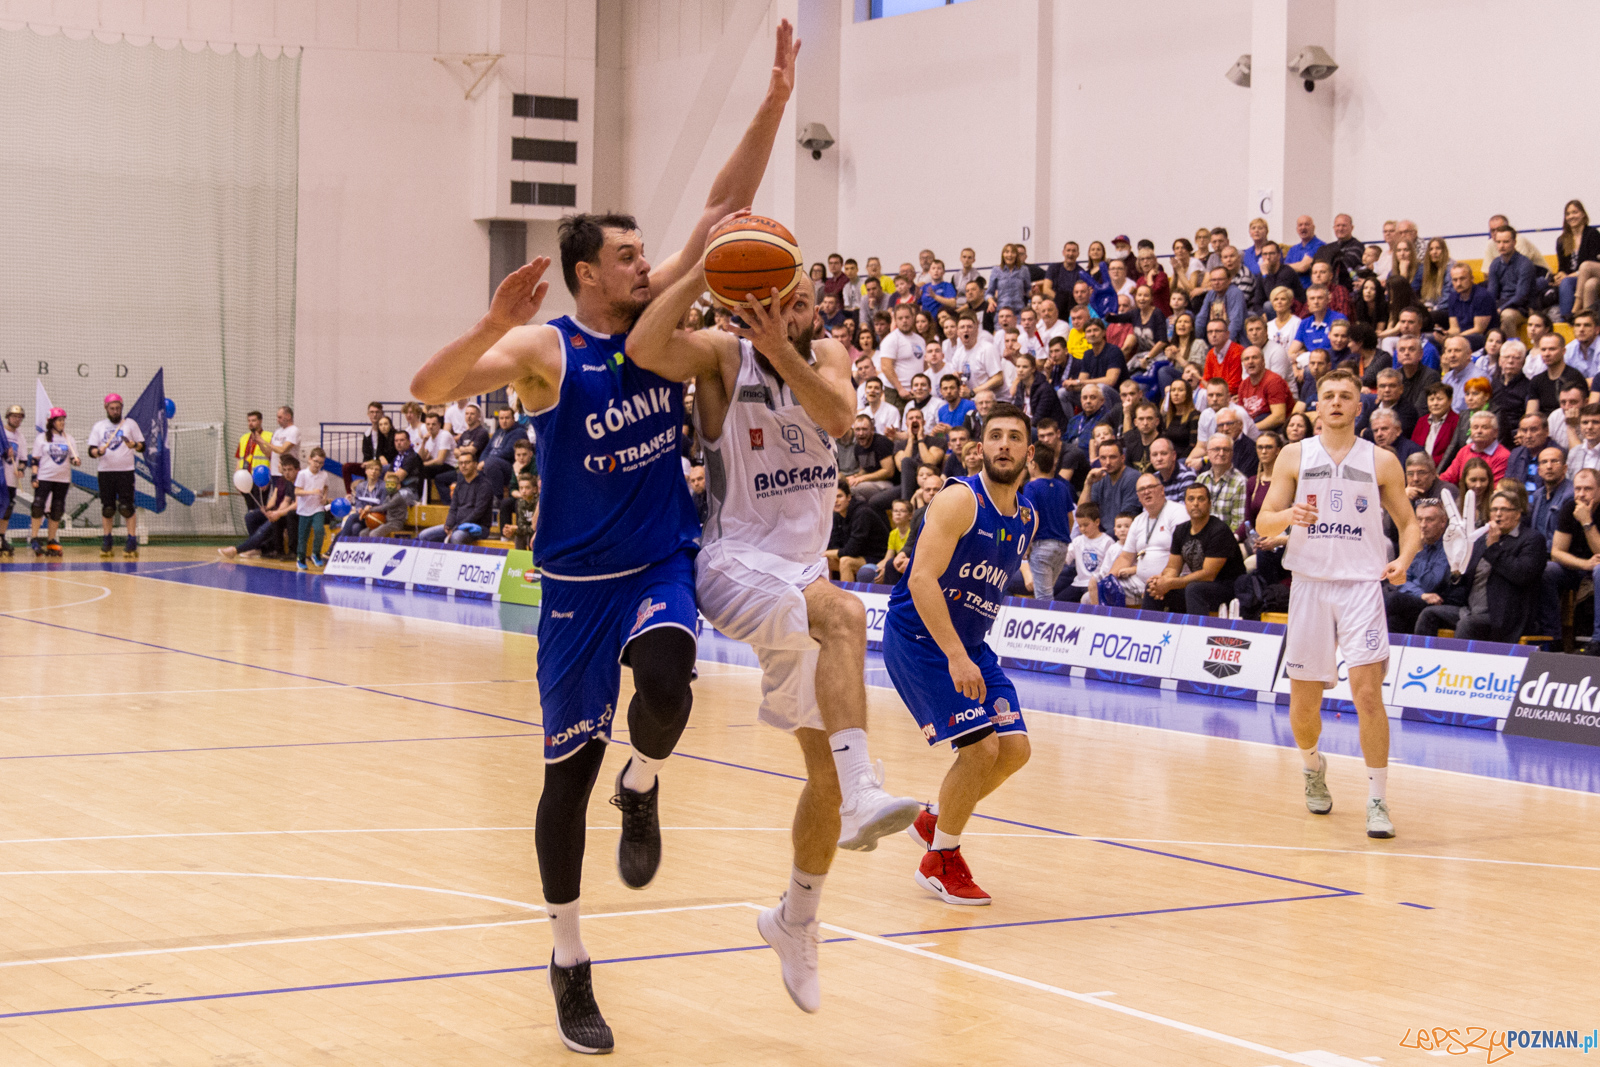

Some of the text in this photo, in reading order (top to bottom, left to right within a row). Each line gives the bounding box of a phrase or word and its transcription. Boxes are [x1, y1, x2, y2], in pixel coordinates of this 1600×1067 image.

[1260, 196, 1272, 215] C
[1022, 226, 1031, 241] D
[37, 361, 49, 375] B
[77, 363, 89, 377] C
[116, 364, 128, 378] D
[585, 387, 671, 440] GÓRNIK
[782, 423, 805, 454] 9
[754, 464, 837, 491] BIOFARM
[756, 489, 783, 500] POLSKI
[1330, 489, 1343, 513] 5
[1307, 522, 1363, 537] BIOFARM
[1017, 533, 1026, 556] 0
[331, 549, 374, 565] BIOFARM
[1003, 618, 1082, 646] BIOFARM
[1366, 629, 1380, 651] 5
[1208, 647, 1242, 664] JOKER
[1436, 667, 1520, 694] funclub
[1435, 686, 1516, 702] biuro podróż
[1514, 706, 1572, 724] DRUKARNIA
